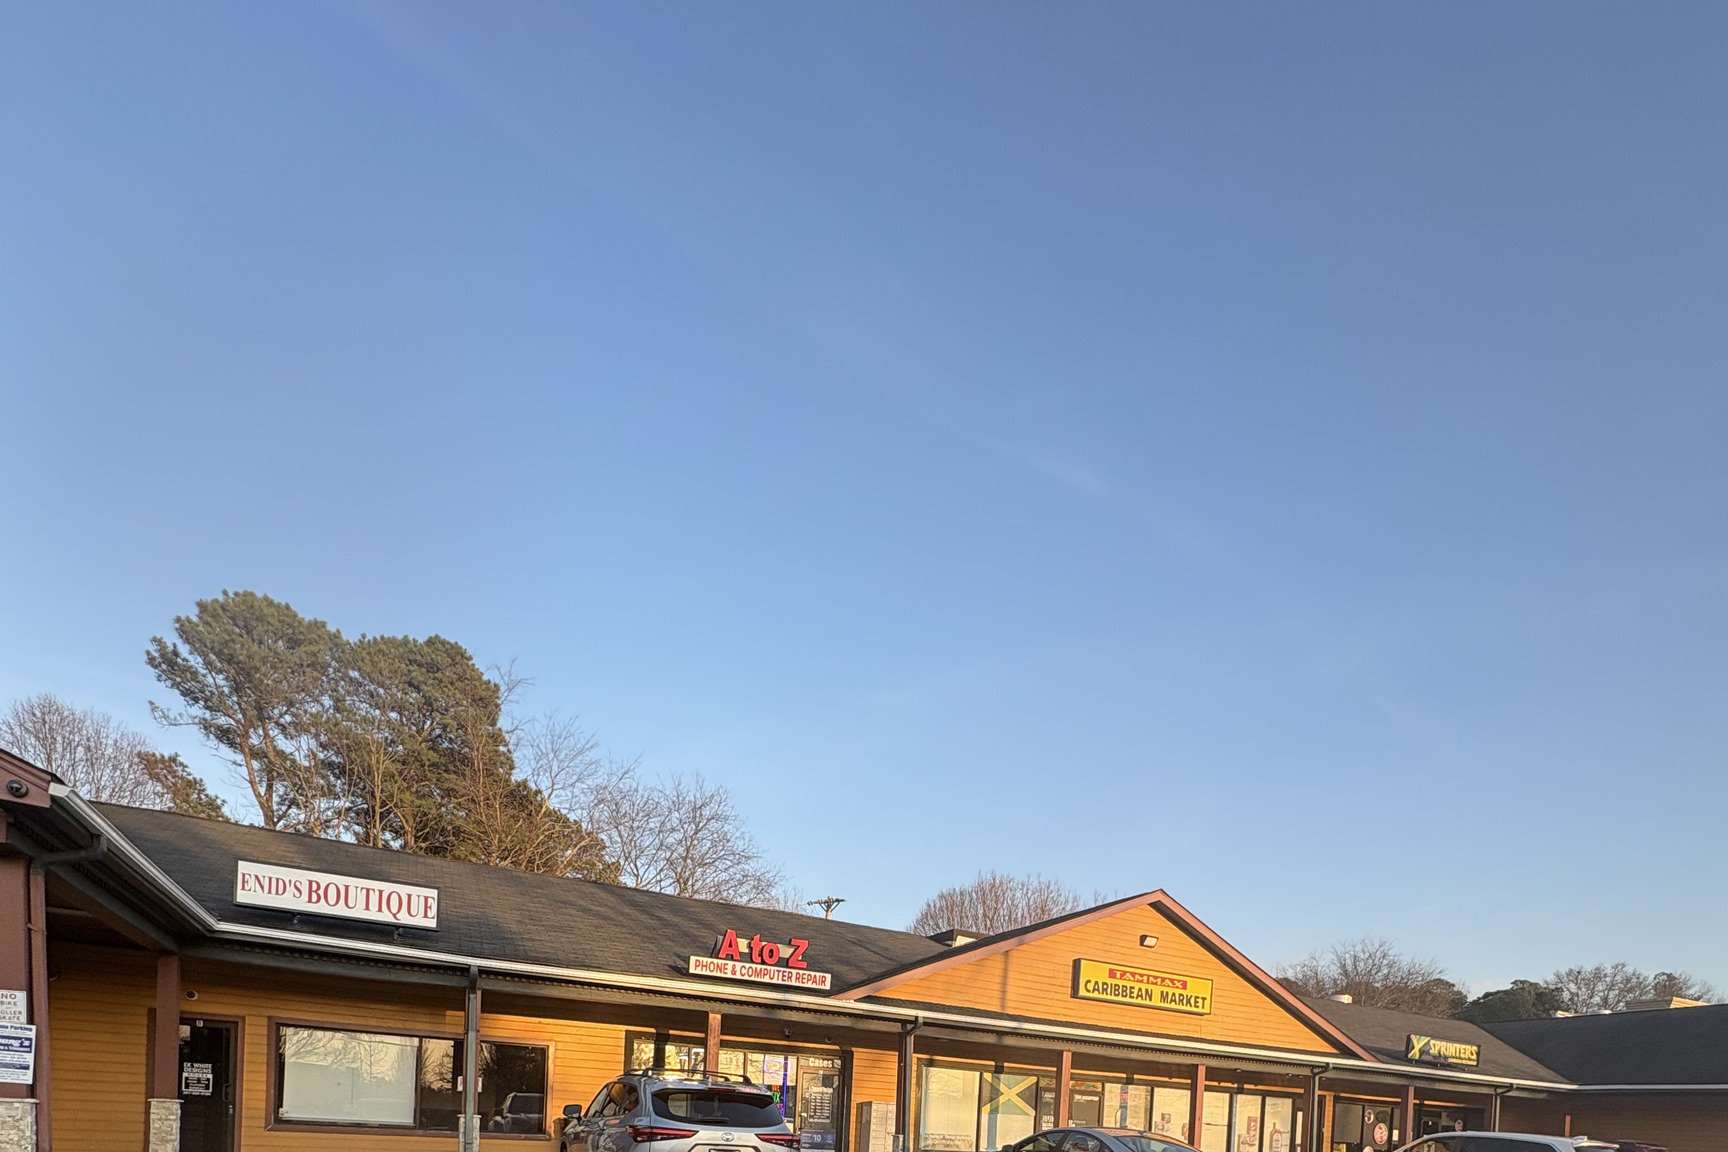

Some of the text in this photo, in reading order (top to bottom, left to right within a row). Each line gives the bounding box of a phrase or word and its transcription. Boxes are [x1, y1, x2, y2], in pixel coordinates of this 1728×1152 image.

[240, 872, 436, 921] ENID'S BOUTIQUE
[718, 928, 809, 969] A to Z
[694, 959, 827, 987] PHONE & COMPUTER REPAIR
[1113, 970, 1184, 989] TAMMAX
[1084, 979, 1207, 1010] CARIBBEAN MARKET
[809, 1057, 833, 1068] Cases
[1429, 1039, 1479, 1061] SPRINTERS
